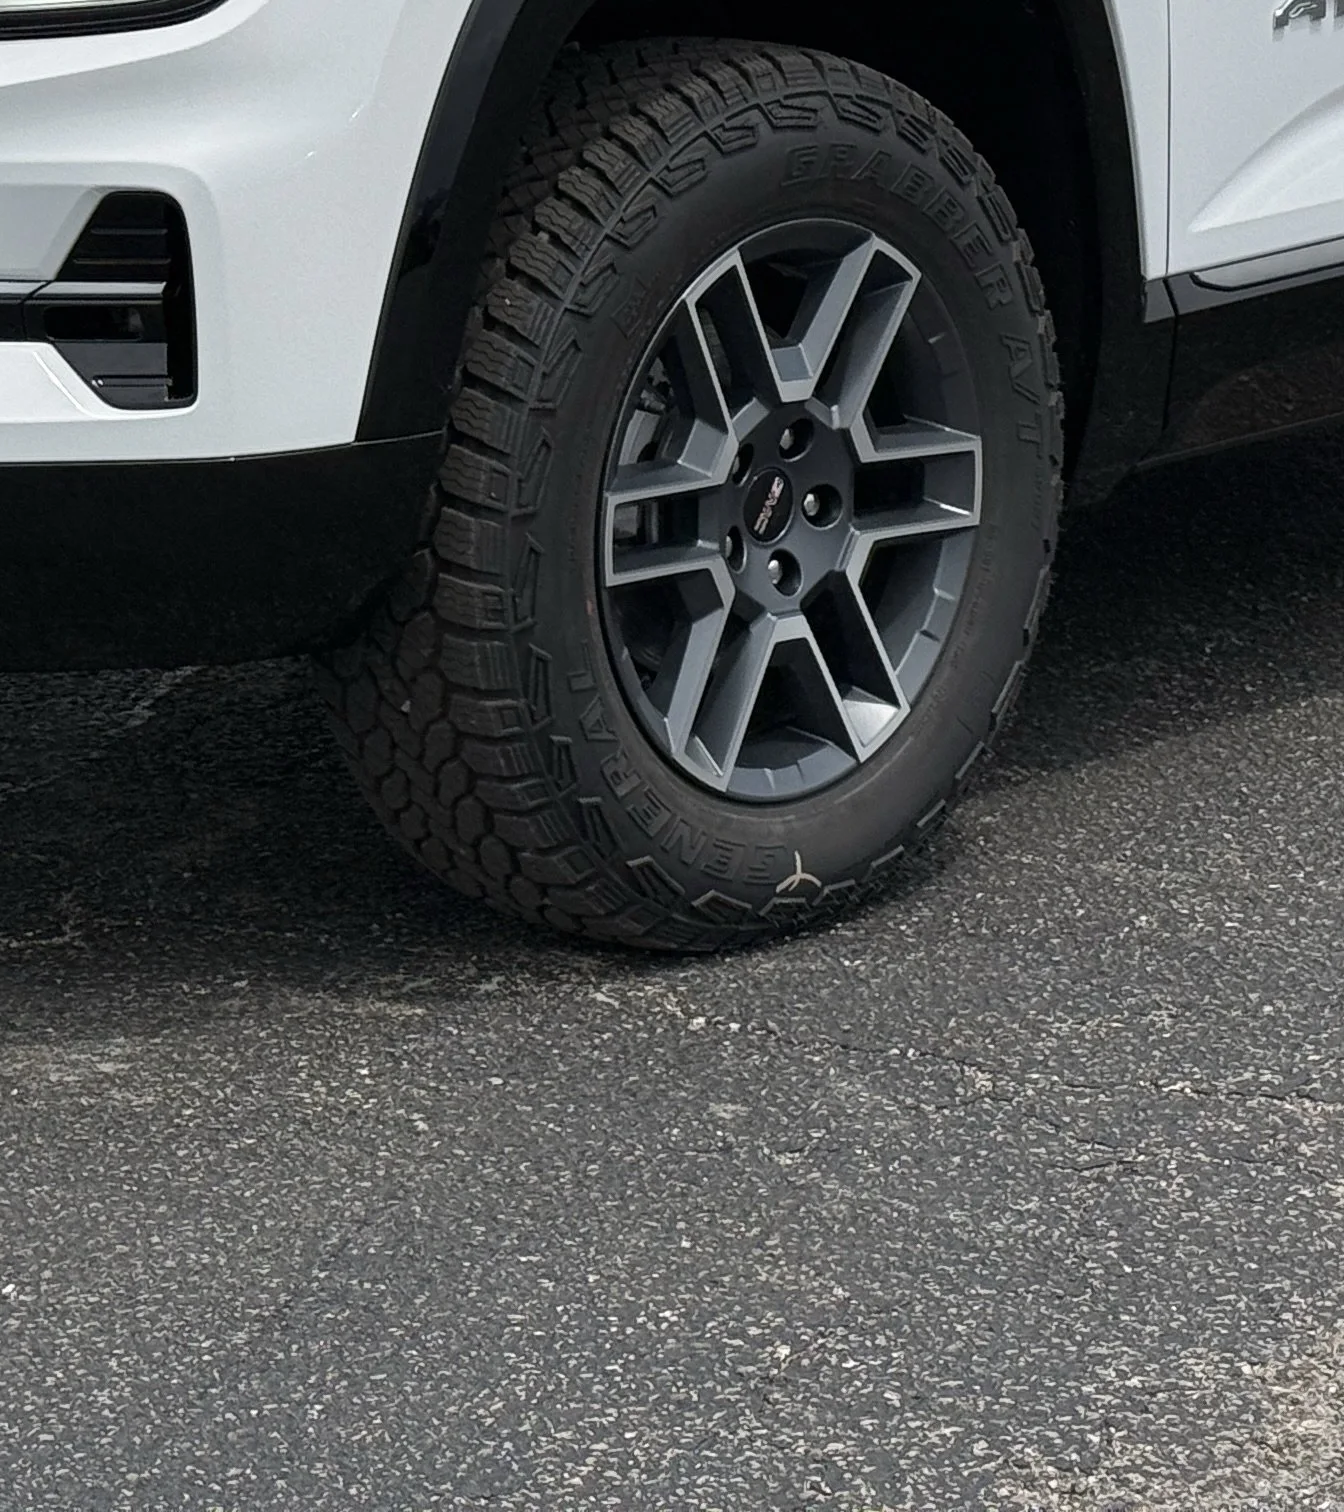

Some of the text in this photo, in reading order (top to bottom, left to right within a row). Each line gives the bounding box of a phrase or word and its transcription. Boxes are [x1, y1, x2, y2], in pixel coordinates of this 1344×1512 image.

[780, 142, 1014, 310] GRABBER
[753, 476, 784, 535] GMC
[567, 640, 787, 885] GENERAL
